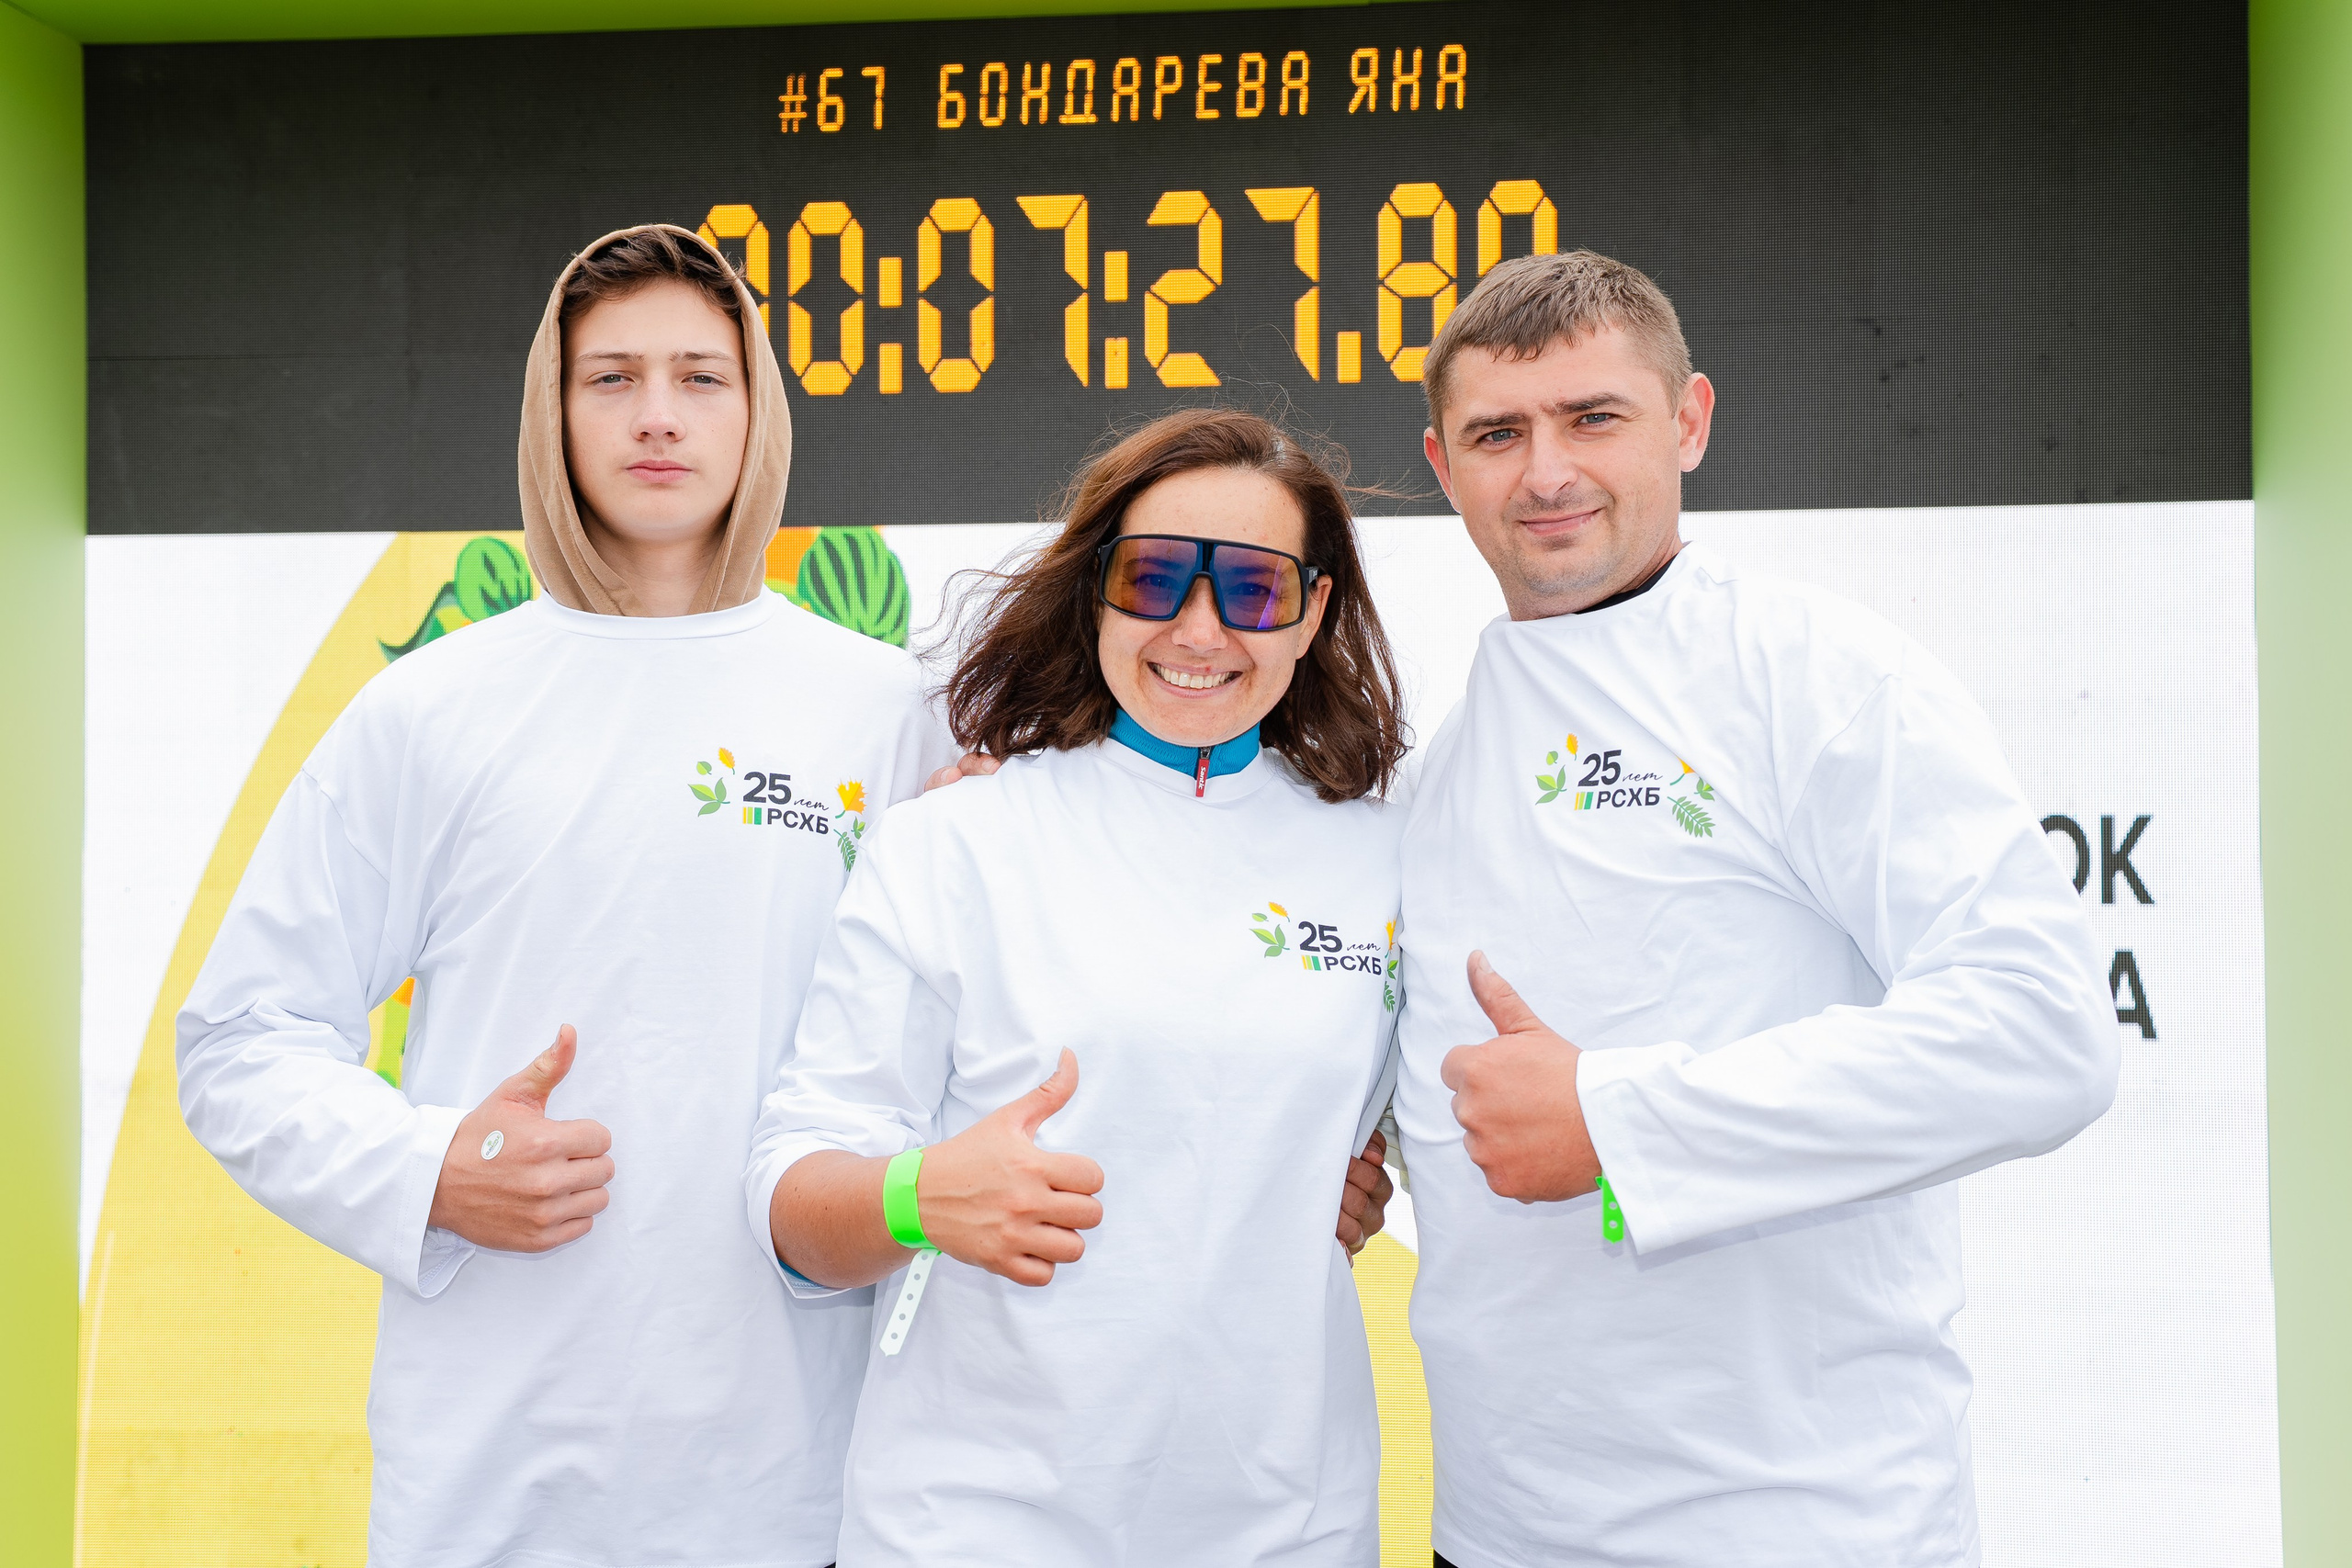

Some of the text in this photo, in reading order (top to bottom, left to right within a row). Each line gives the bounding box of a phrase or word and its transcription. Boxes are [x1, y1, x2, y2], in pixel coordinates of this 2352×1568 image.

[777, 43, 1467, 133] #67 БОНДАРЕВА ЯНА
[1198, 766, 1206, 790] Santic
[1577, 749, 1623, 787] 25
[742, 771, 792, 806] 25
[1596, 786, 1661, 809] РСХБ
[766, 807, 830, 835] РСХБ
[1297, 920, 1343, 953] 25
[1323, 954, 1383, 976] РСХБ
